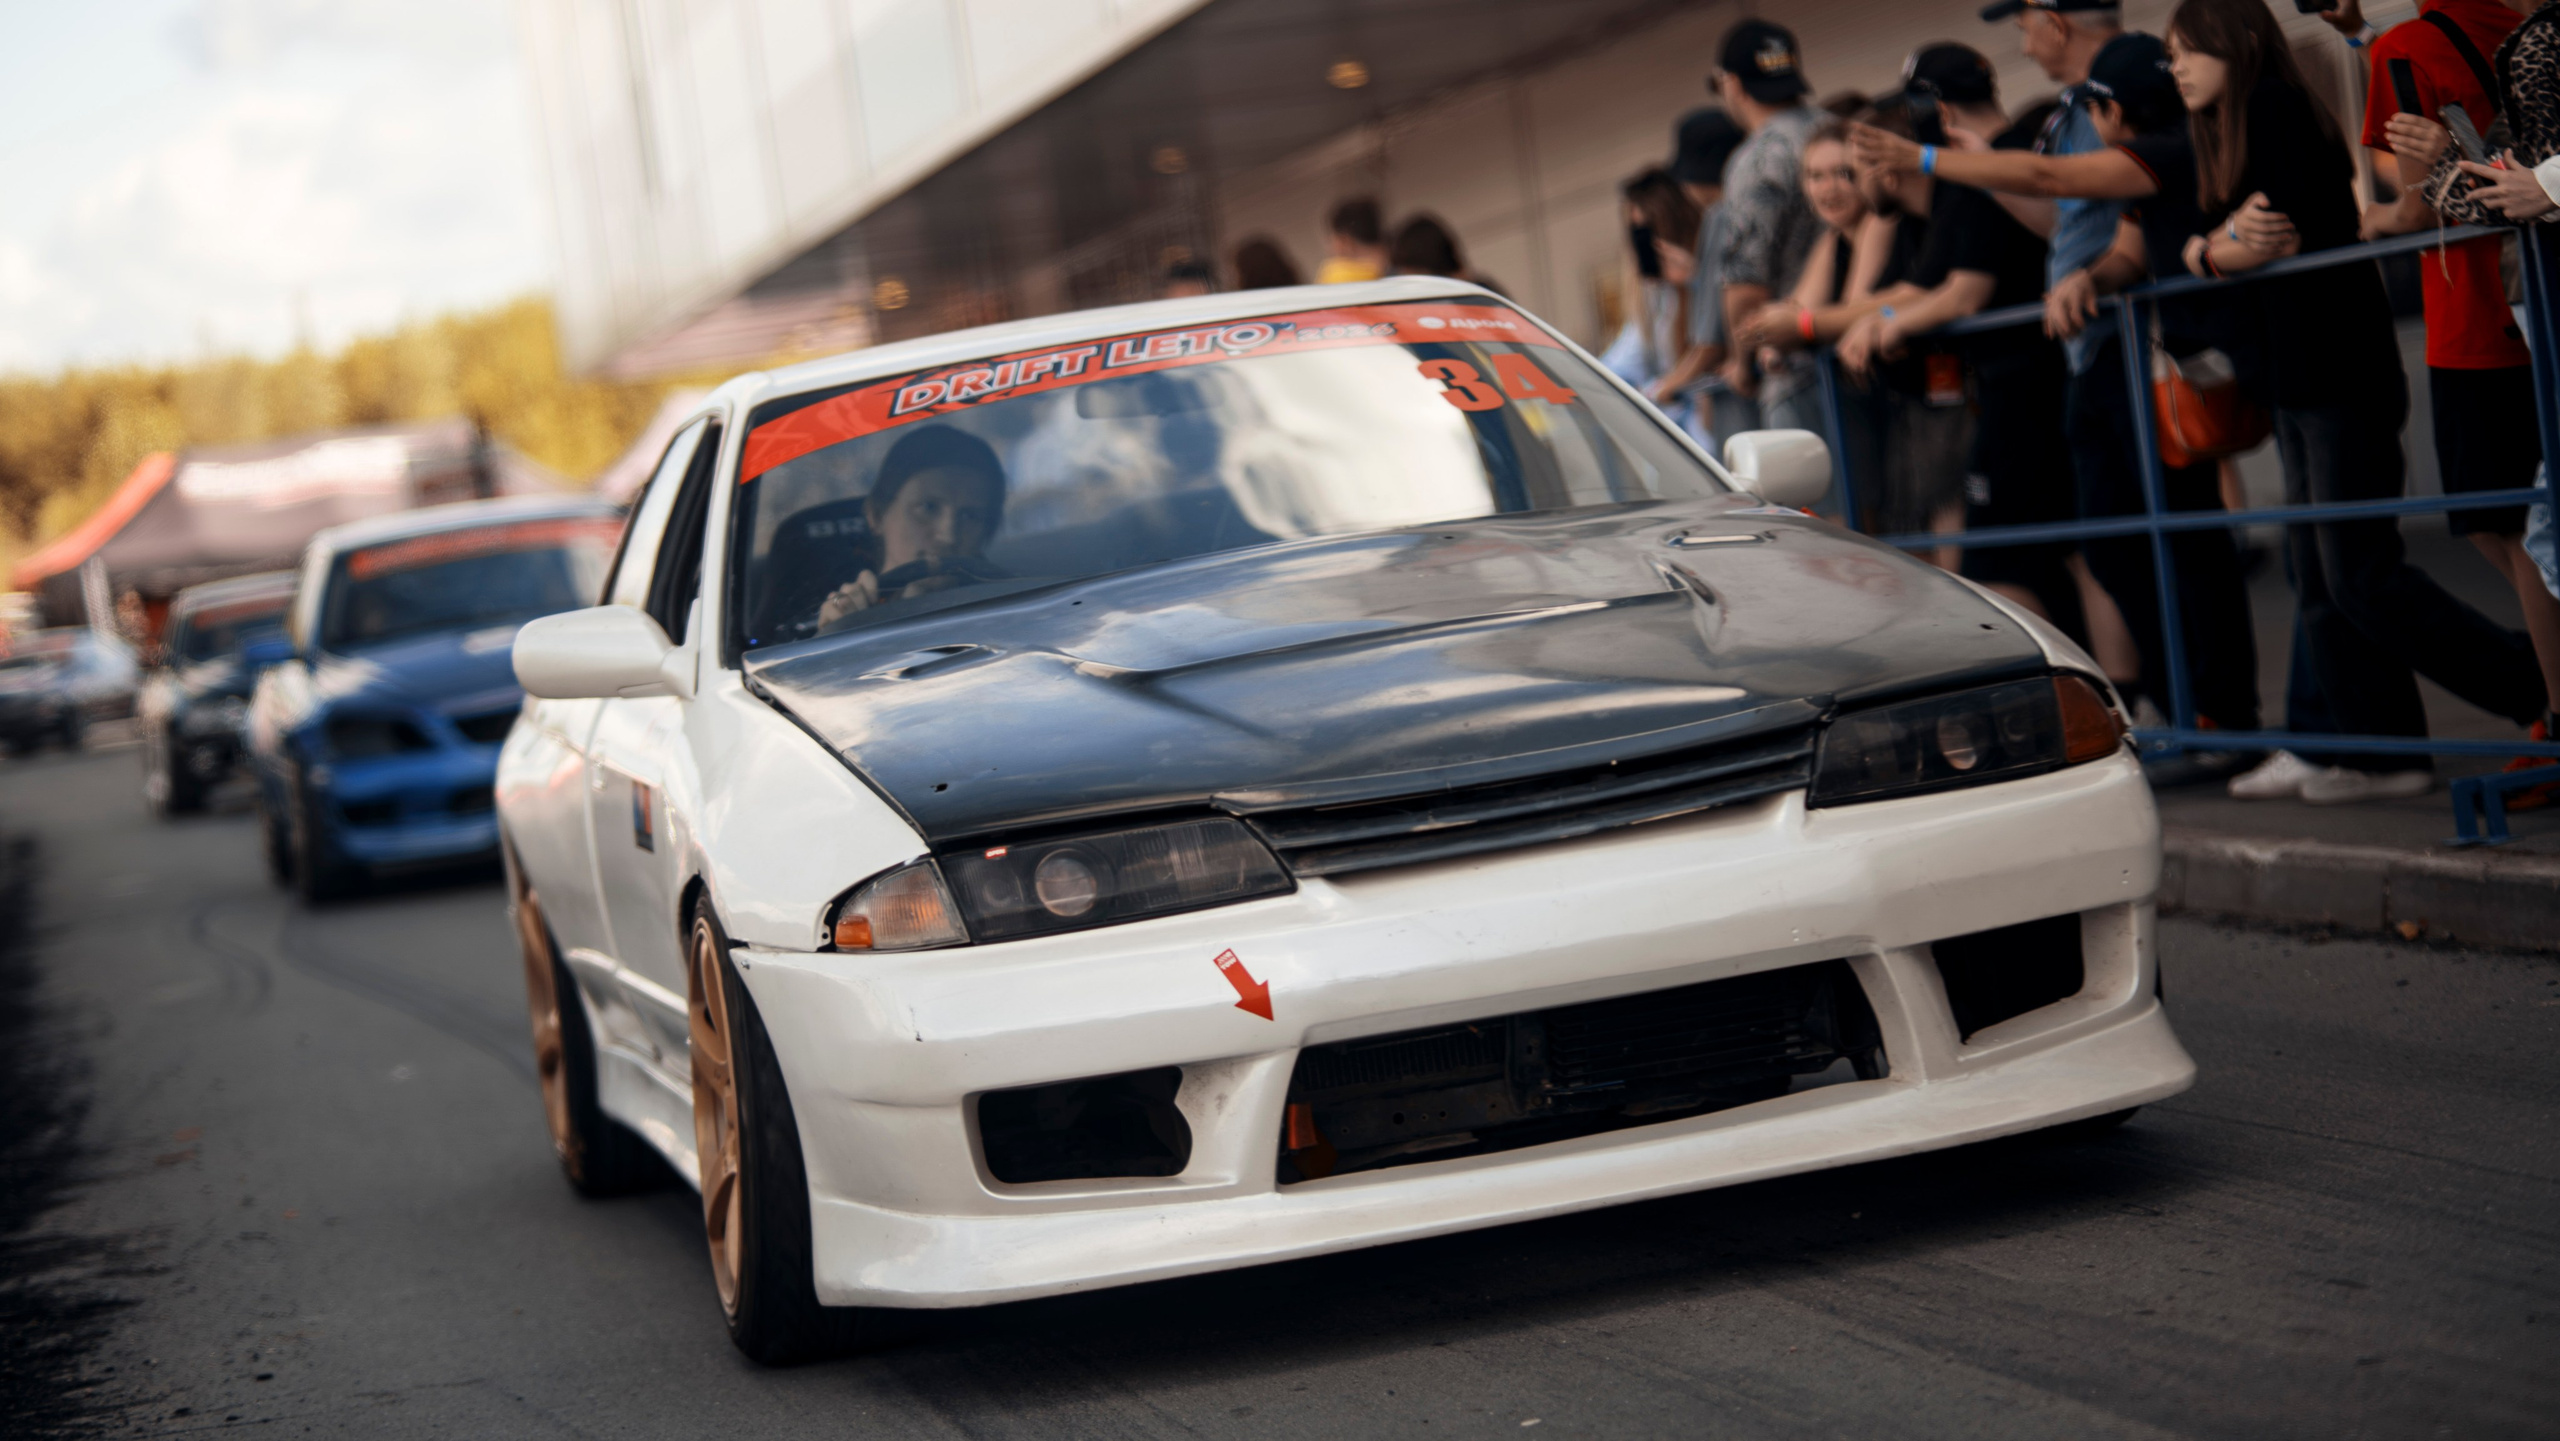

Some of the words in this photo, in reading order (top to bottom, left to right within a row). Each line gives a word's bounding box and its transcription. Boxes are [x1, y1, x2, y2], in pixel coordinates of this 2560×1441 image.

[892, 346, 1098, 415] DRIFT
[1107, 323, 1275, 367] LETO
[1417, 353, 1579, 412] 34
